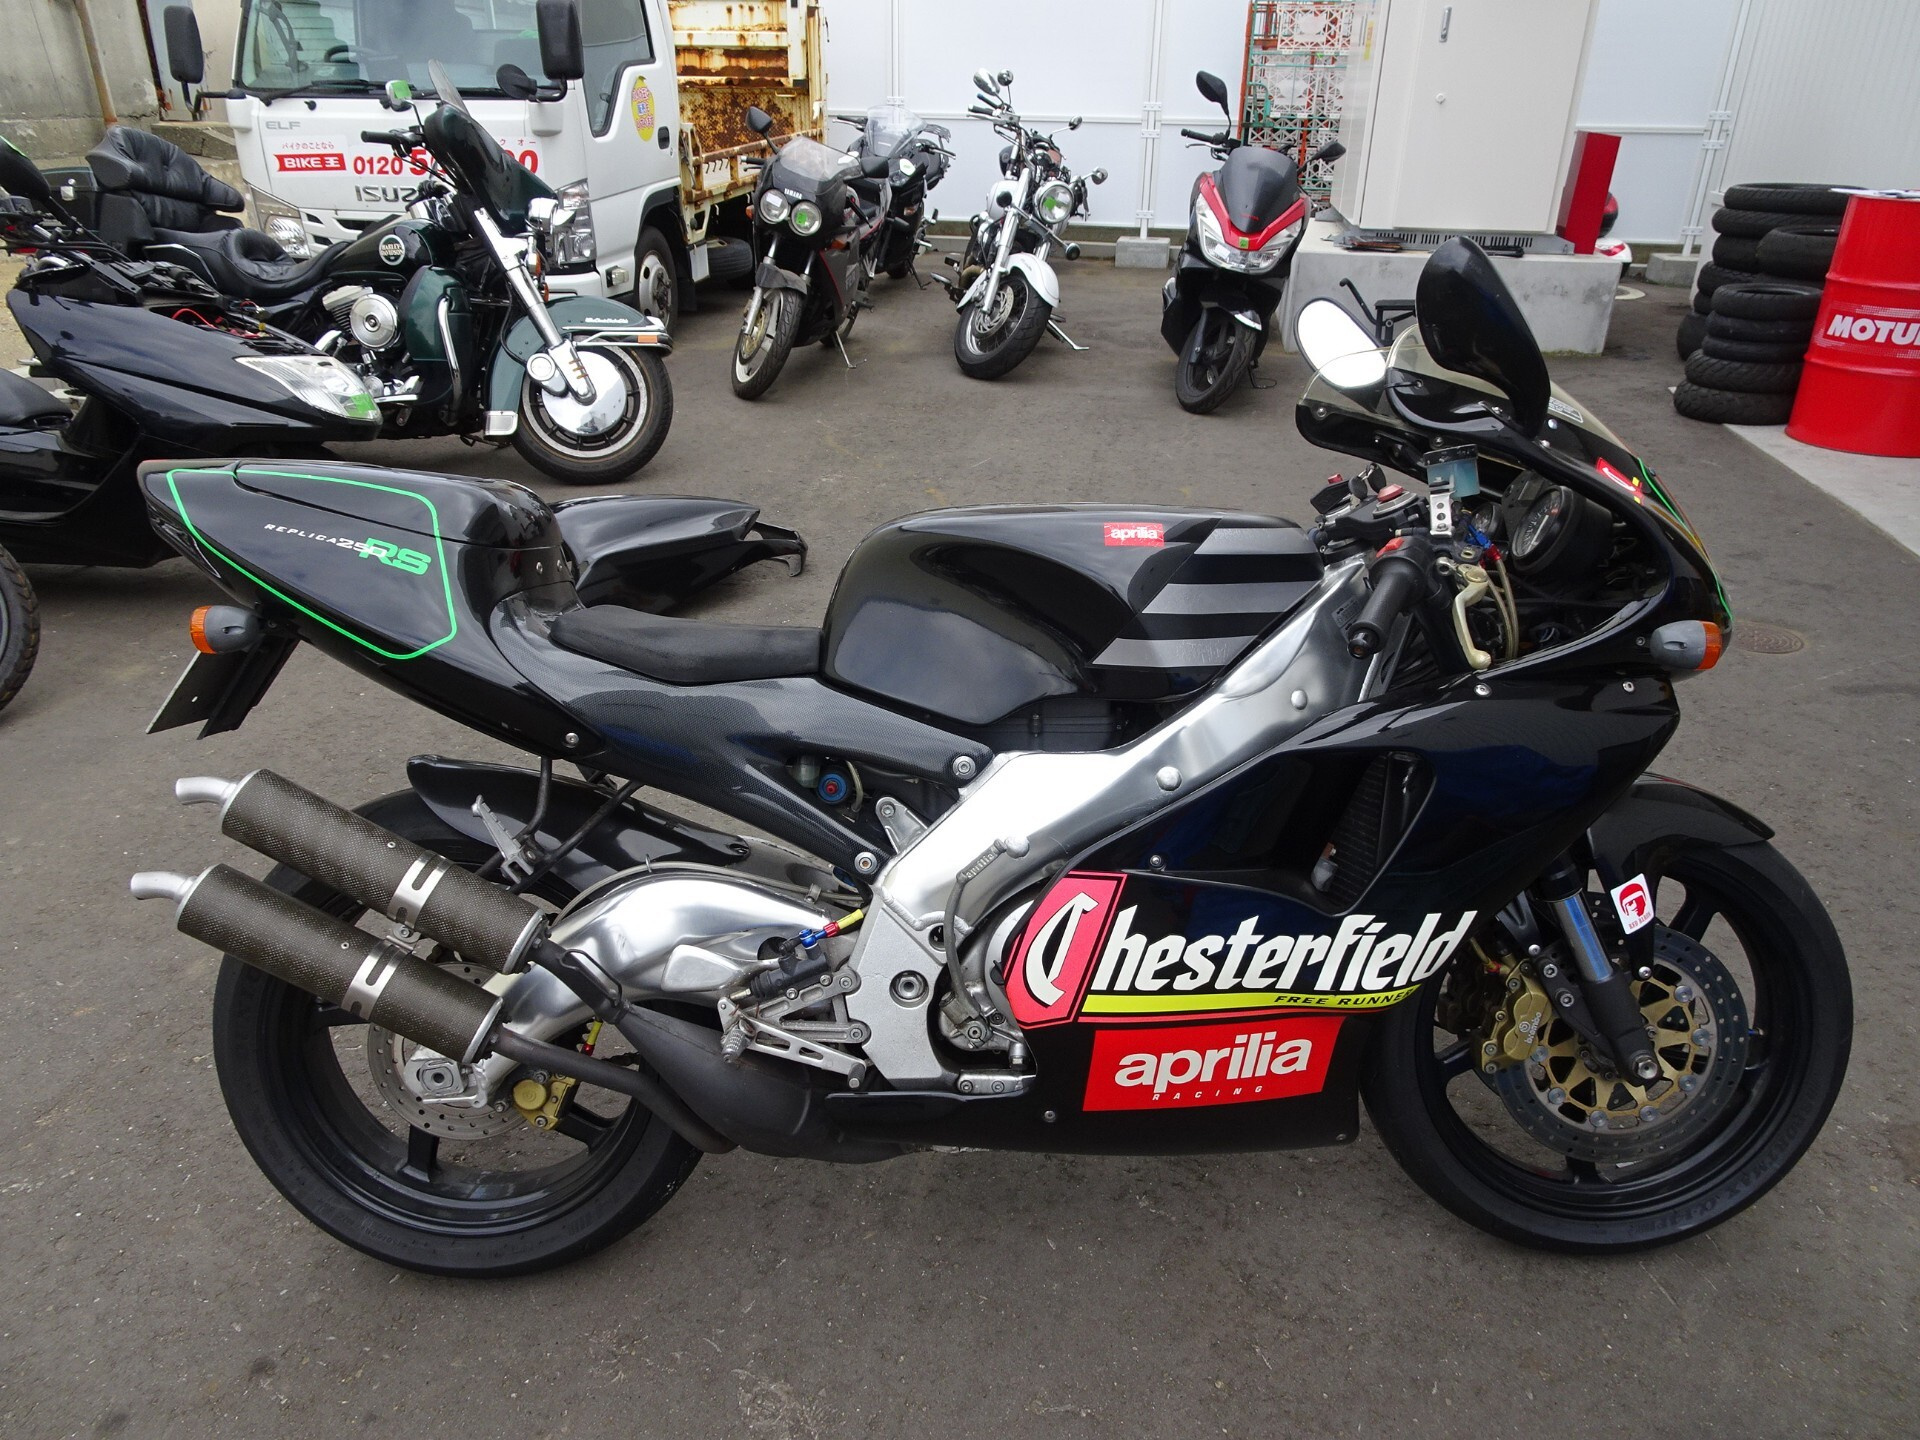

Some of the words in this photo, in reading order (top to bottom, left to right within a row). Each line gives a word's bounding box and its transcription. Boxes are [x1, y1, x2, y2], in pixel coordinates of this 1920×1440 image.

[265, 121, 301, 130] ELF
[282, 141, 335, 150] バイクのことなら
[284, 157, 323, 168] BIKE
[353, 156, 403, 175] 0120
[355, 185, 418, 202] ISUZ
[1110, 526, 1158, 541] aprilia
[359, 537, 432, 575] RS
[965, 853, 995, 878] aprilia
[1023, 892, 1478, 1007] Chesterfield
[1274, 995, 1330, 1006] FREE
[1524, 1011, 1542, 1044] brembo
[1115, 1030, 1313, 1094] aprilia
[1152, 1085, 1263, 1101] RACING
